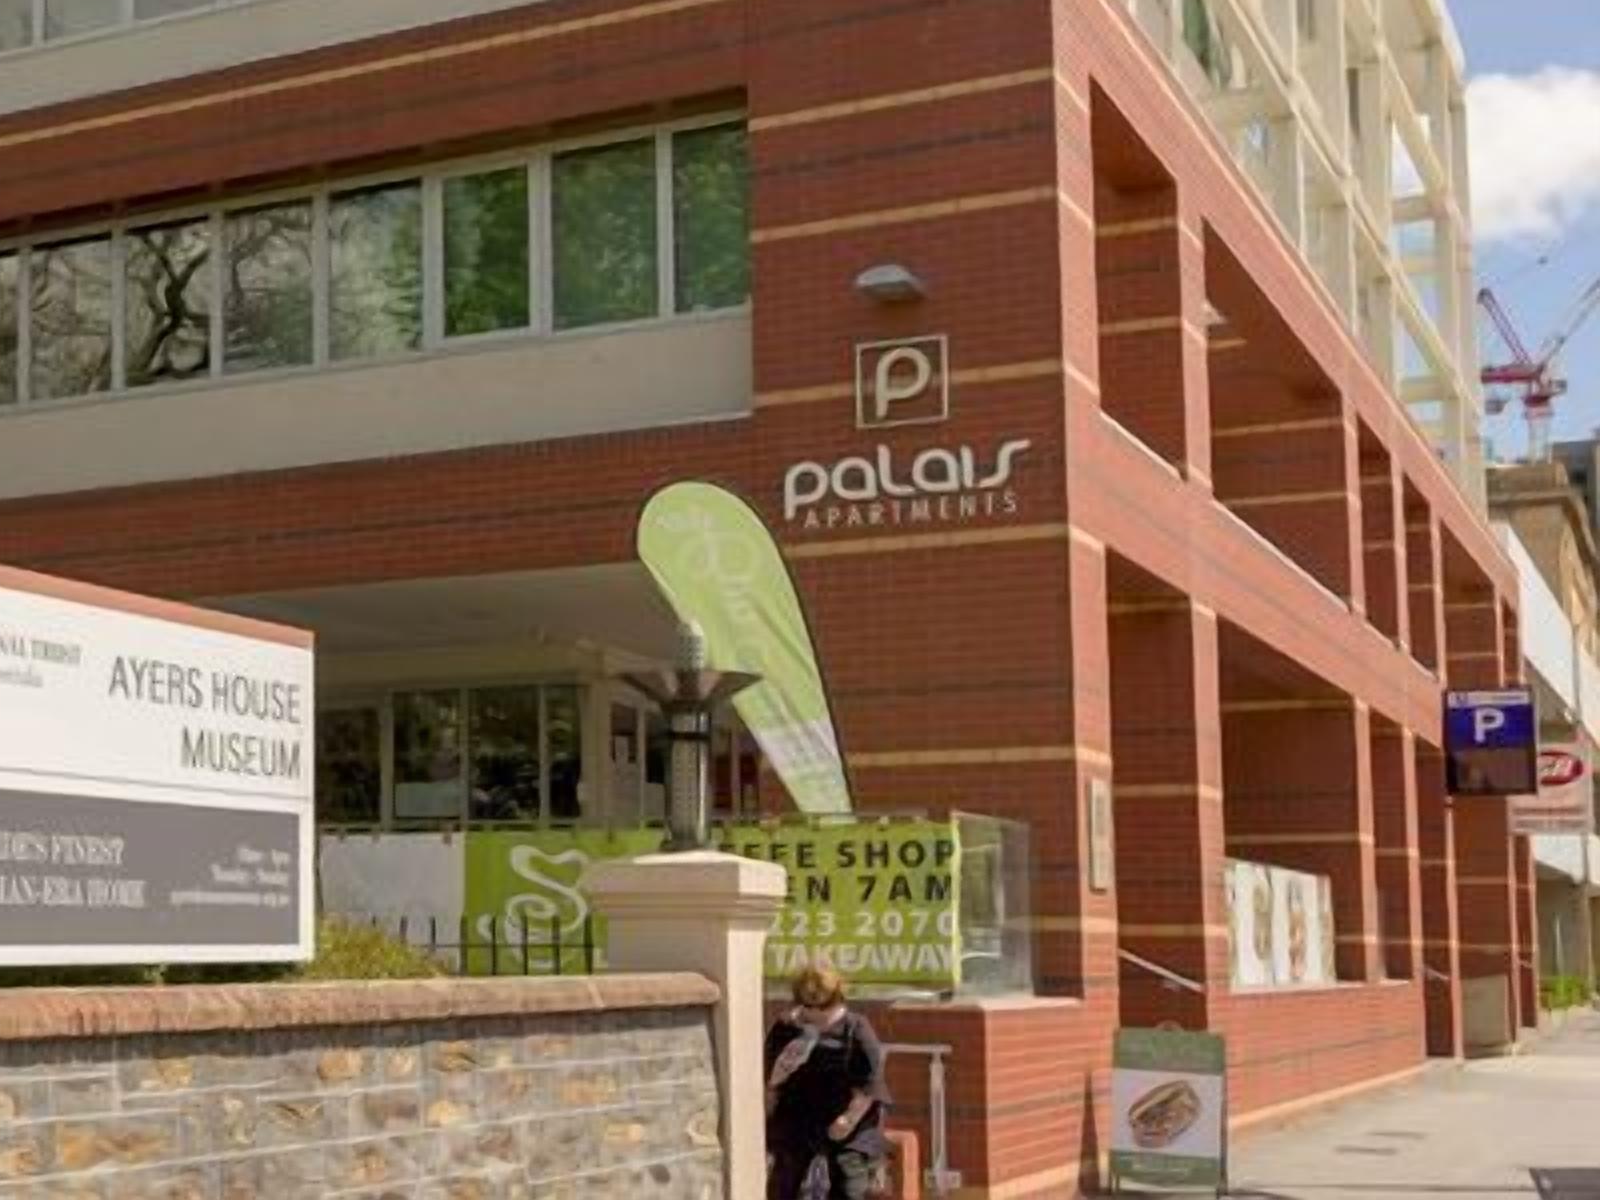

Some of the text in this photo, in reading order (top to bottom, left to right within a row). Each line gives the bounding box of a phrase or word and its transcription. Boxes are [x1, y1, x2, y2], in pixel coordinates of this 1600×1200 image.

[875, 347, 932, 419] P
[803, 486, 1018, 529] APARTMENTS
[108, 655, 301, 725] AYERS HOUSE
[1474, 707, 1505, 742] P
[180, 725, 301, 779] MUSEUM
[836, 840, 954, 869] SHOP
[768, 943, 954, 973] TAKEAWAY
